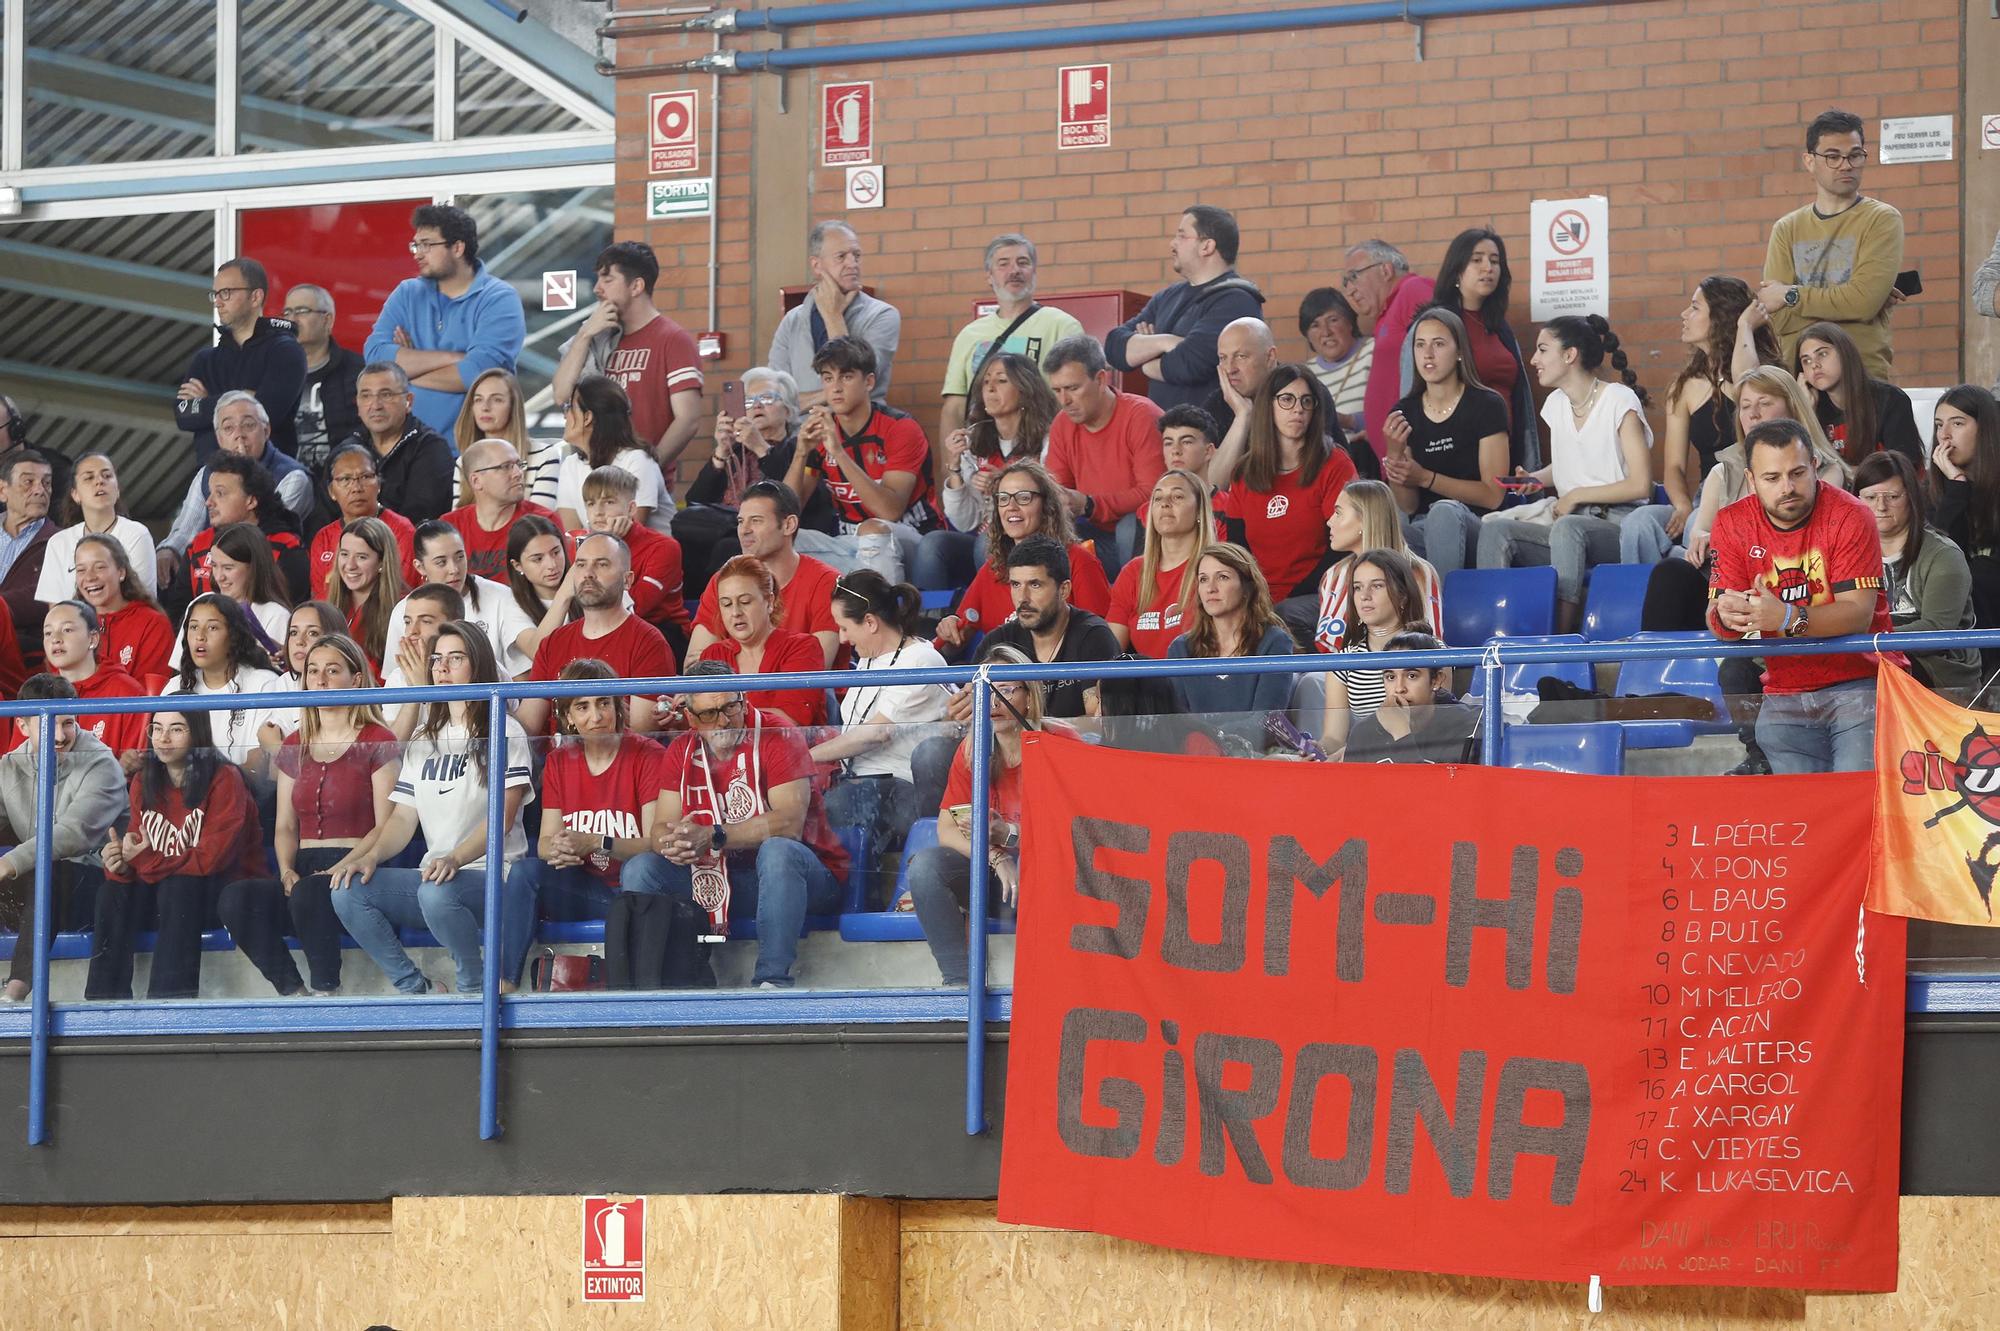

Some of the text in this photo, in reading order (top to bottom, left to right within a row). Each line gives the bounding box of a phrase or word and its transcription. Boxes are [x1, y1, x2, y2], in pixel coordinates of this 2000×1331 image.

[1063, 124, 1105, 134] BOCA DE
[1063, 135, 1106, 145] INCENDIO
[654, 150, 694, 159] POLSADOR
[826, 151, 868, 162] EXTINTOR
[654, 182, 708, 198] SORTIDA
[421, 753, 470, 782] NIKE
[1665, 824, 1678, 847] 3
[1662, 856, 1673, 879] 4
[1715, 856, 1788, 879] PONS
[1662, 888, 1679, 911] 6
[1713, 887, 1786, 912] BAUS
[1661, 920, 1675, 942] 8
[1710, 919, 1783, 943] PUIG
[1656, 952, 1669, 974] 9
[1641, 984, 1670, 1005] 10
[1708, 977, 1802, 1007] MELERO
[1641, 1017, 1667, 1038] 11
[1639, 1048, 1668, 1070] 13
[1708, 1040, 1812, 1066] WALTERS
[1639, 1079, 1665, 1100] 16
[1694, 1072, 1799, 1096] CARGOL
[1635, 1111, 1658, 1130] 17
[1692, 1103, 1795, 1127] XARGAY
[1627, 1138, 1649, 1160] 19
[1691, 1136, 1801, 1160] VIEYTES
[1619, 1170, 1647, 1192] 24
[1696, 1168, 1854, 1193] LUKASEVICA
[1617, 1256, 1667, 1272] ANNA
[587, 1277, 641, 1294] EXTINTOR
